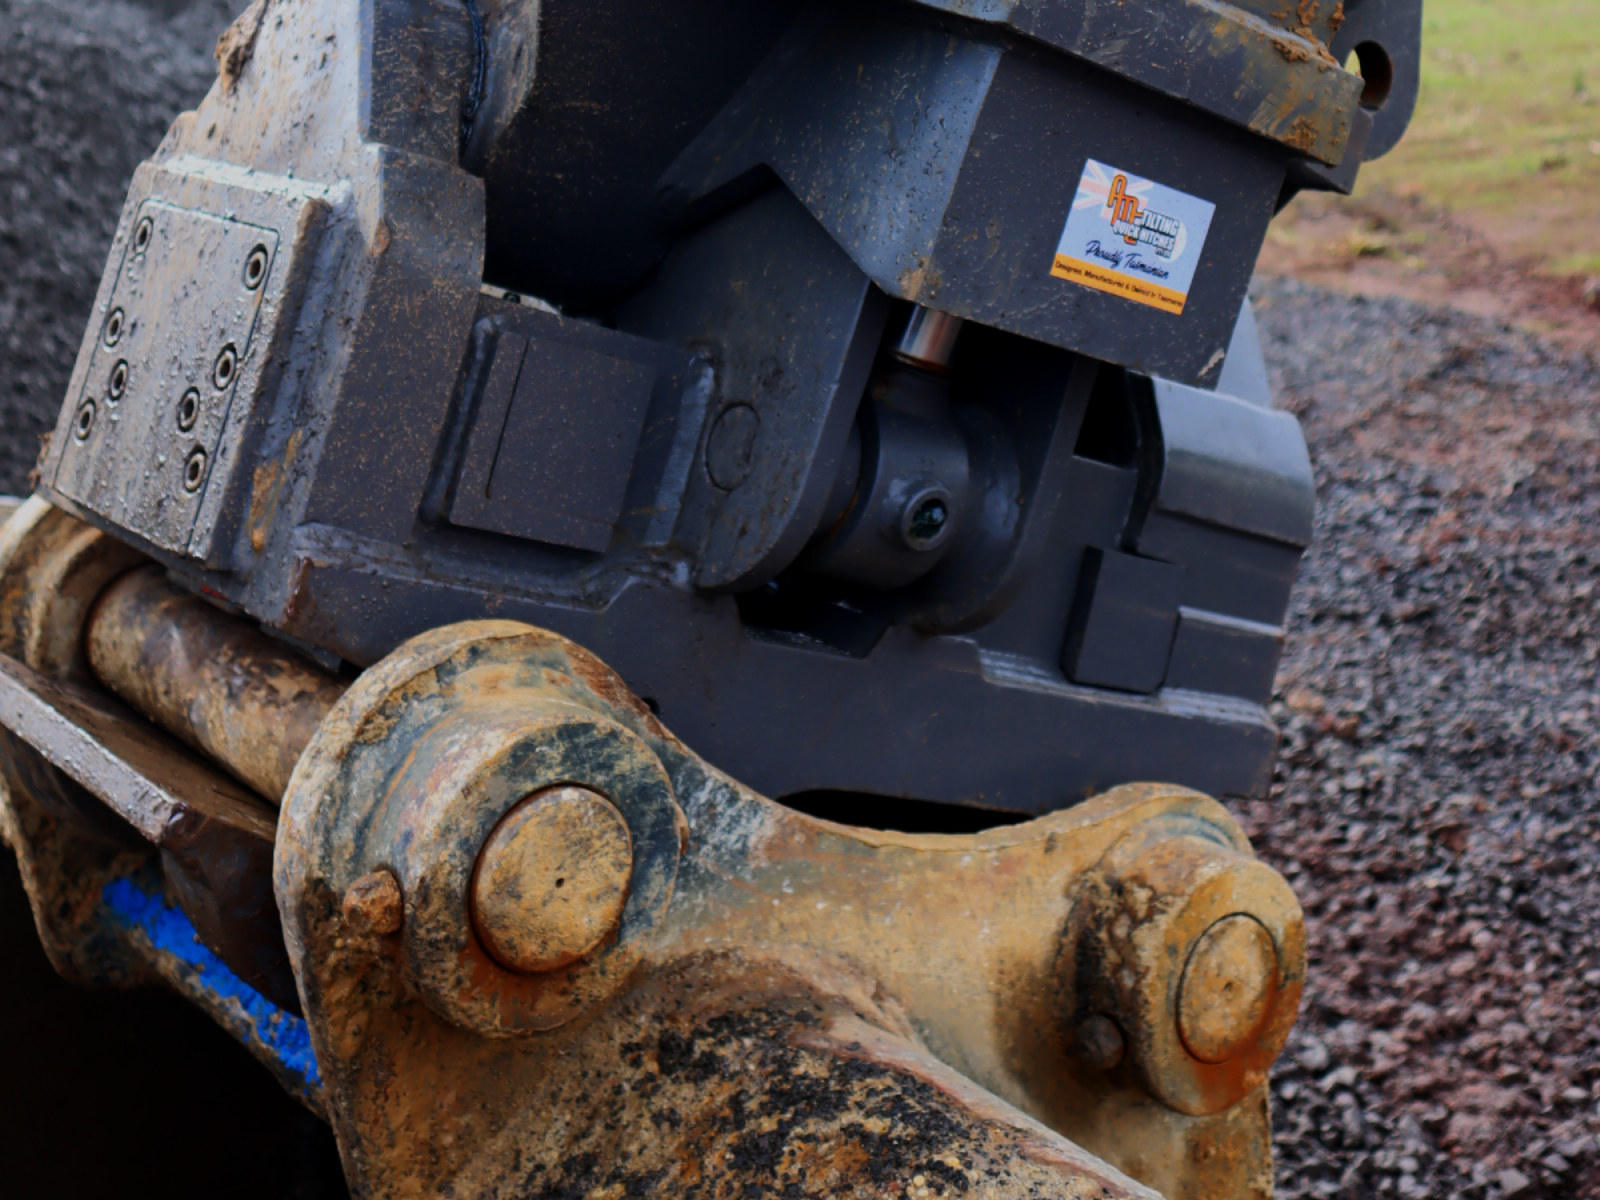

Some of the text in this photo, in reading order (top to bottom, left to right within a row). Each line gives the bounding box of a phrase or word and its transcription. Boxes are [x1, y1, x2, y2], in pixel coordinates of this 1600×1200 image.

[1112, 219, 1176, 252] QUICK HITCHES
[1142, 209, 1180, 238] TILTING
[1085, 240, 1124, 269] Proudly
[1124, 253, 1169, 280] Tasmanian
[1084, 270, 1124, 289] Manufactured
